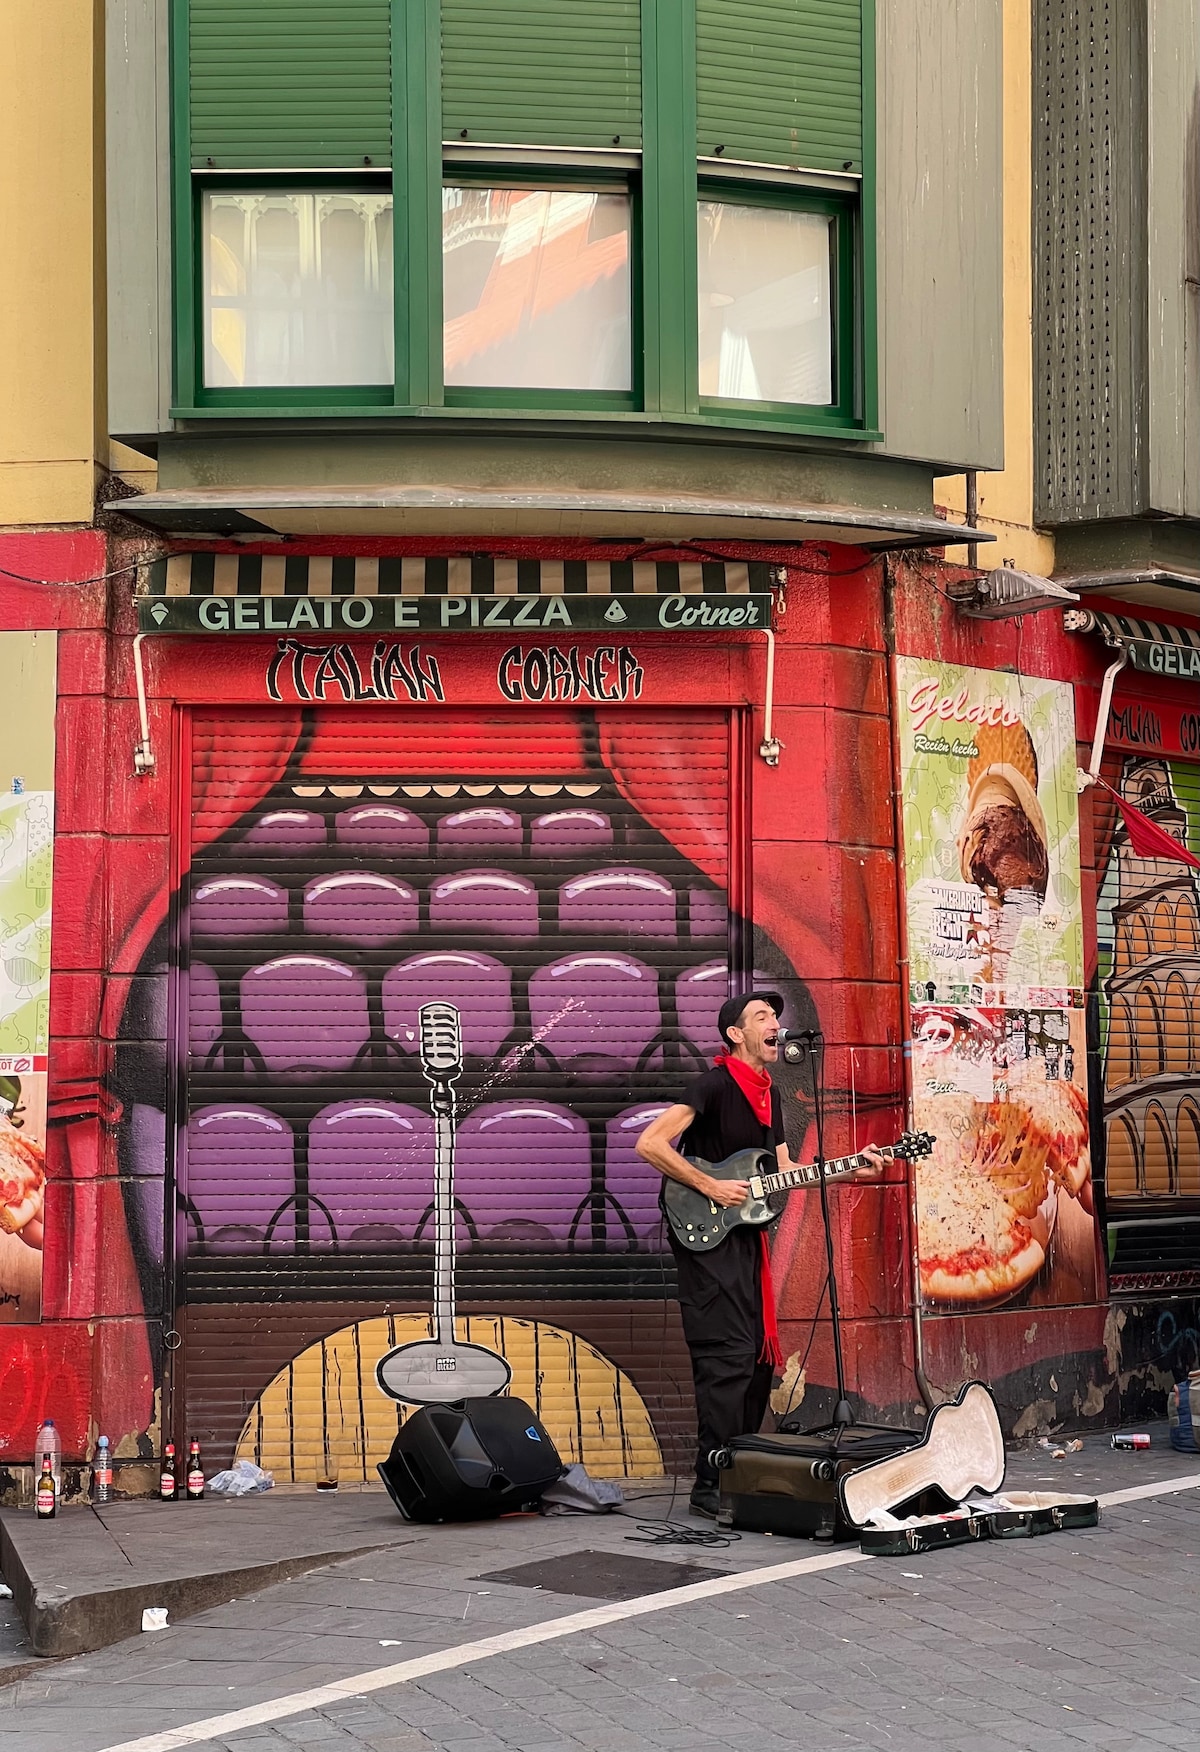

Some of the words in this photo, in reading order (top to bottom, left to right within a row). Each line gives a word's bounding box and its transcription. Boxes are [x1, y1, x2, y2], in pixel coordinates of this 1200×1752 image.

[199, 597, 373, 630] GELATO
[395, 597, 419, 627] E
[440, 596, 572, 628] PIZZA
[659, 595, 759, 628] Corner
[498, 646, 643, 702] CORNER
[907, 677, 1019, 731] Gelato
[915, 735, 949, 753] Recién
[952, 738, 979, 756] hecho
